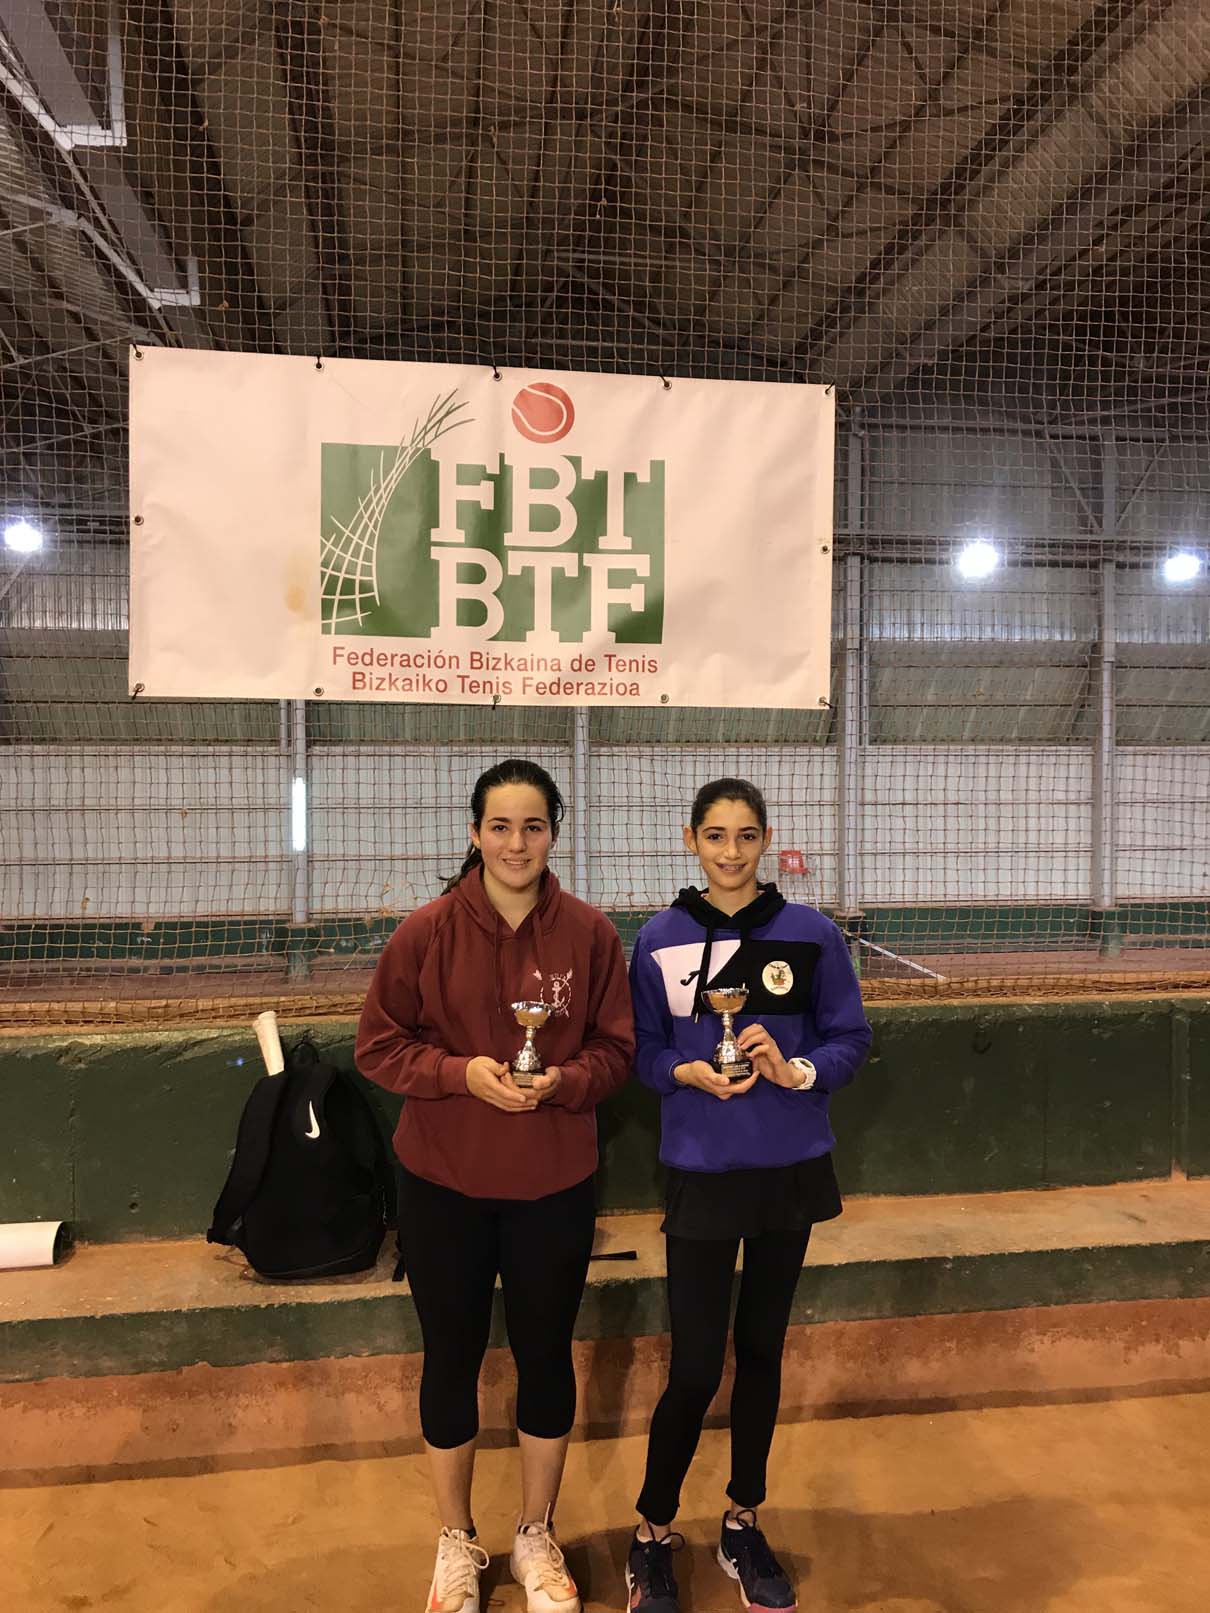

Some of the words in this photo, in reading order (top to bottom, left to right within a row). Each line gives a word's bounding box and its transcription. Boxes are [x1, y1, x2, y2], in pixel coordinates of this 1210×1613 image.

[431, 448, 650, 550] FBT
[431, 546, 650, 643] BTF
[332, 646, 460, 670] Federación
[469, 651, 562, 672] Bizkaina
[570, 653, 596, 673] de
[603, 654, 659, 674] Tenis
[351, 671, 448, 693] Bizkaiko
[456, 674, 513, 695] Tenis
[522, 676, 641, 697] Federazioa
